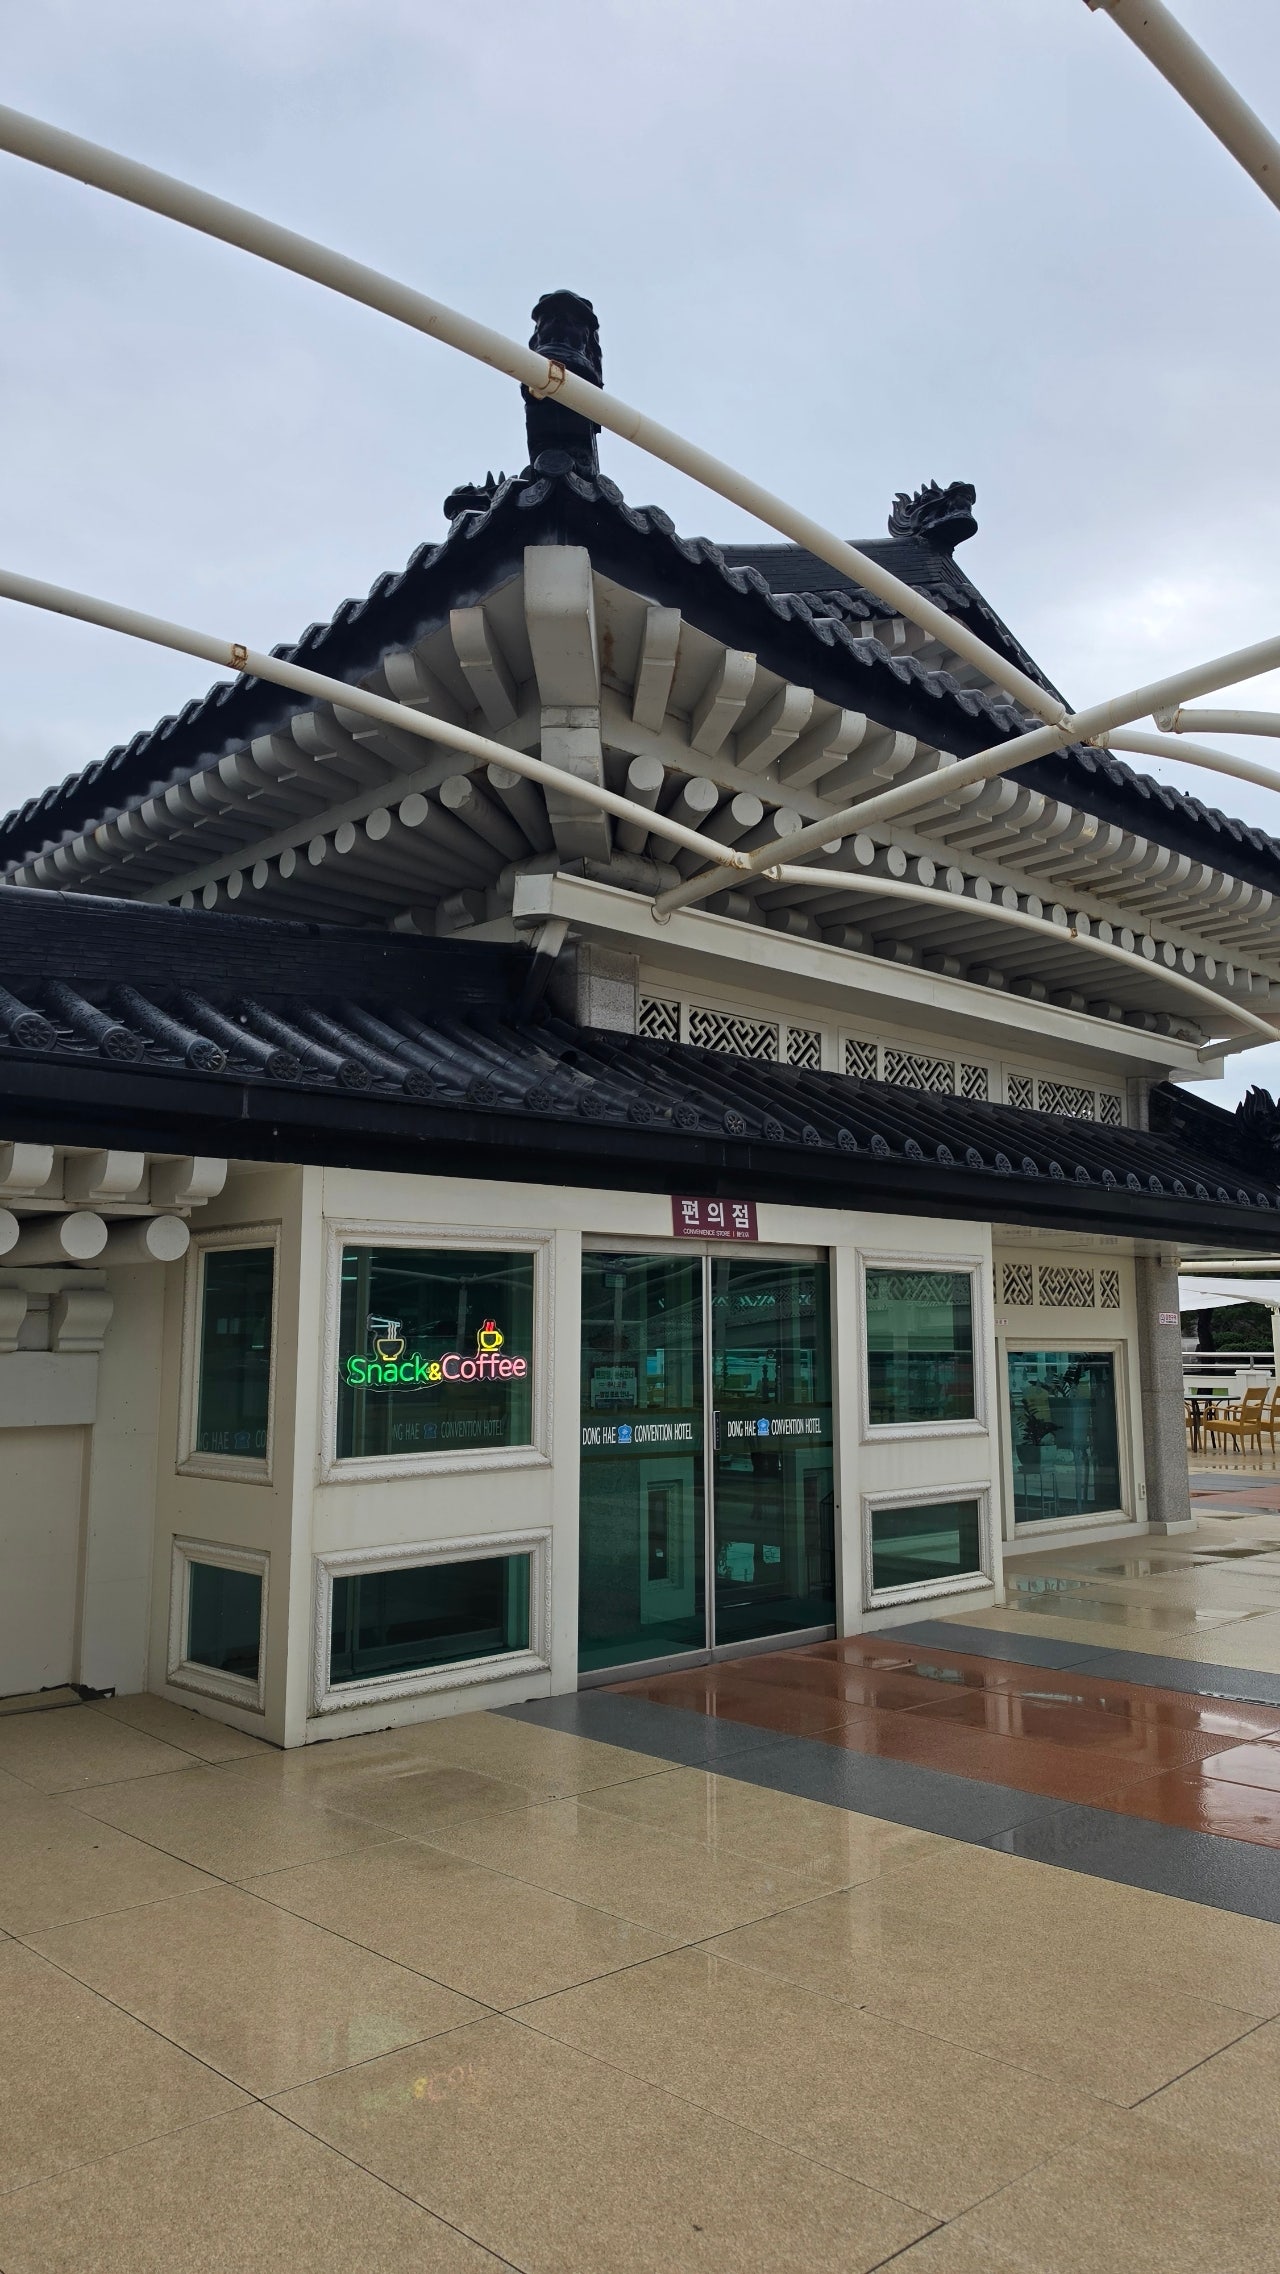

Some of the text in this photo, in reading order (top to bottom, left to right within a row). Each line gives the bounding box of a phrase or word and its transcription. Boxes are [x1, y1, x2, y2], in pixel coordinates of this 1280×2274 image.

[681, 1200, 749, 1229] 편의점
[683, 1227, 715, 1237] CONVENIENCE
[716, 1230, 730, 1238] STORE
[405, 1422, 420, 1440] HAE
[440, 1419, 482, 1439] CONVENTION
[483, 1419, 504, 1437] HOTEL
[582, 1422, 693, 1446] DONG HAE CONVENTION HOTEL
[727, 1420, 744, 1438] DONG
[744, 1420, 757, 1437] HAE
[771, 1418, 804, 1436] CONVENTION
[805, 1417, 822, 1434] HOTEL
[211, 1431, 230, 1452] HAE
